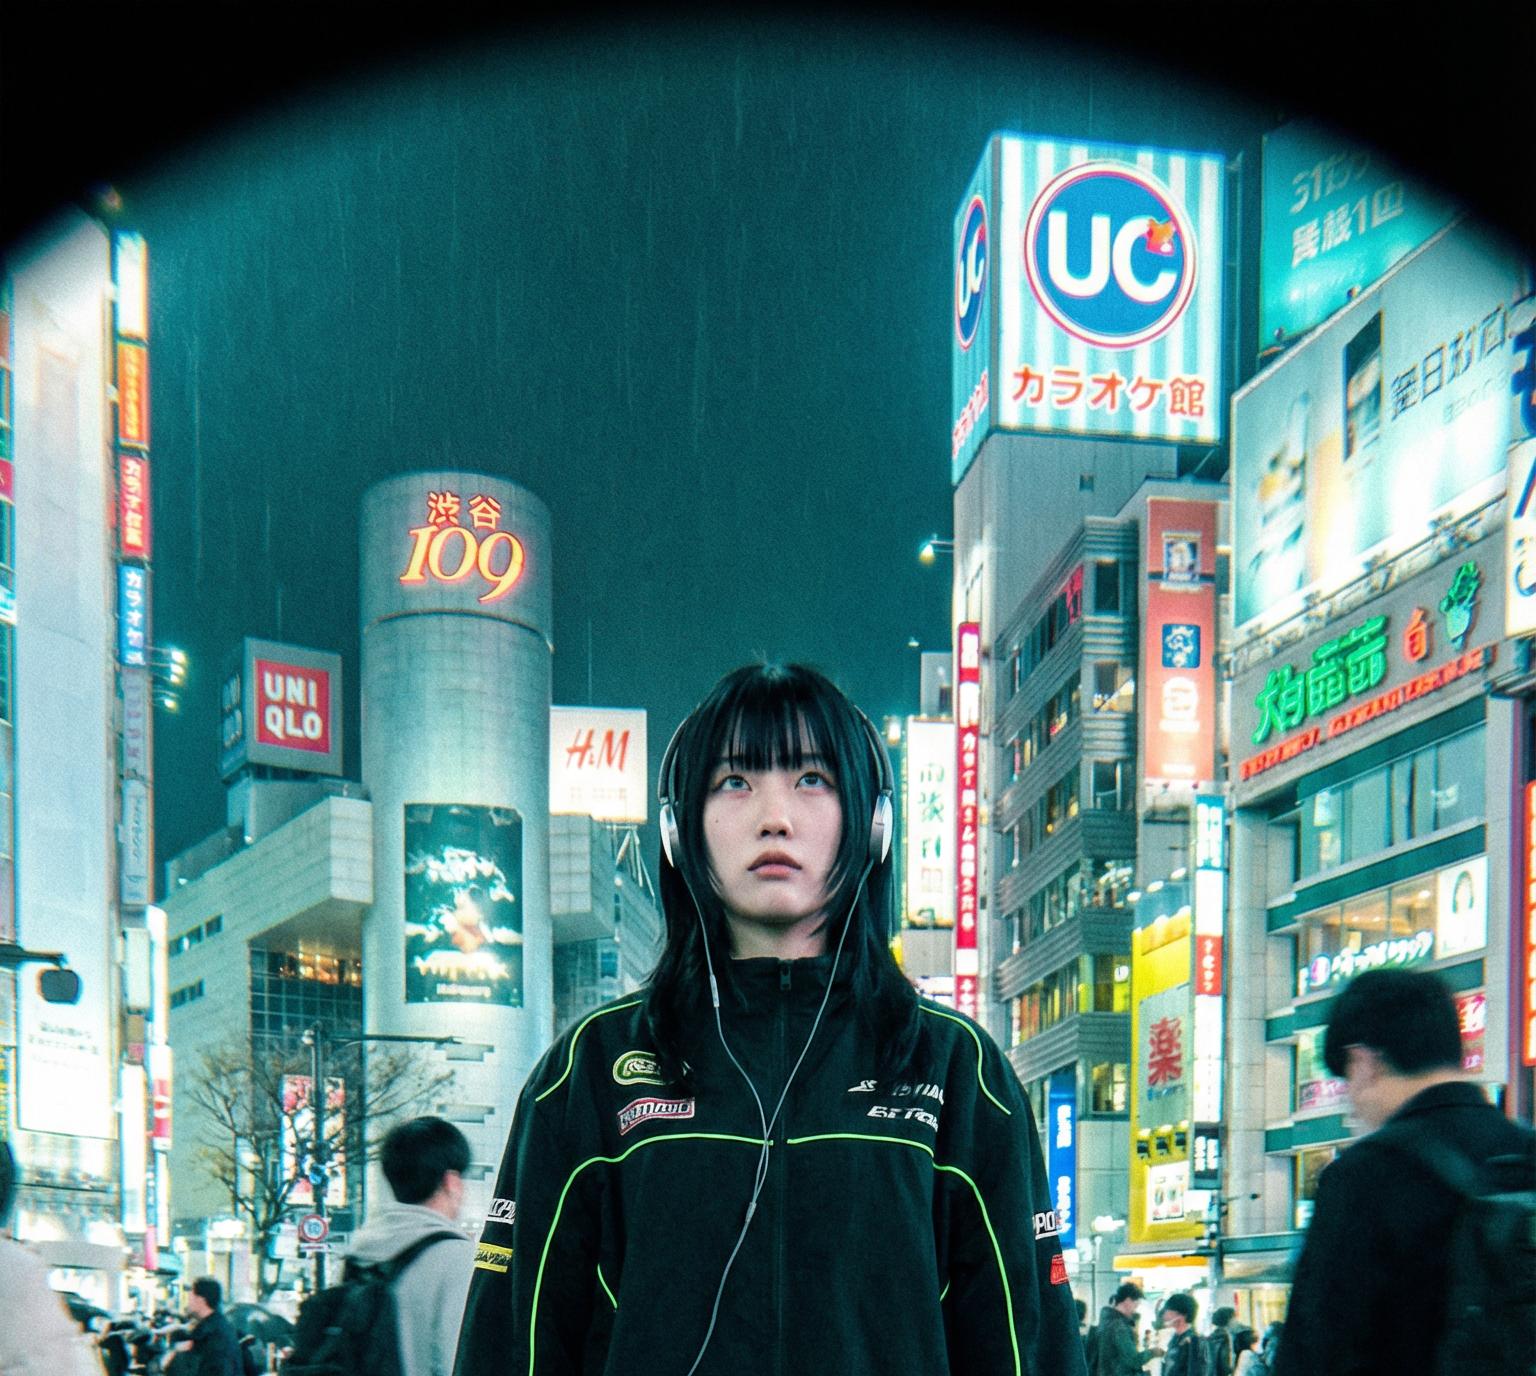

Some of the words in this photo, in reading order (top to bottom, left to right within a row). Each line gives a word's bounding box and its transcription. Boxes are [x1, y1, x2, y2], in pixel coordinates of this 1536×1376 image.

[1048, 210, 1177, 303] UC
[1012, 366, 1205, 418] カラオケ館
[427, 491, 502, 529] 渋谷
[400, 525, 524, 602] 109
[264, 671, 317, 708] UNI
[265, 704, 323, 740] QLO
[565, 729, 630, 771] H&M
